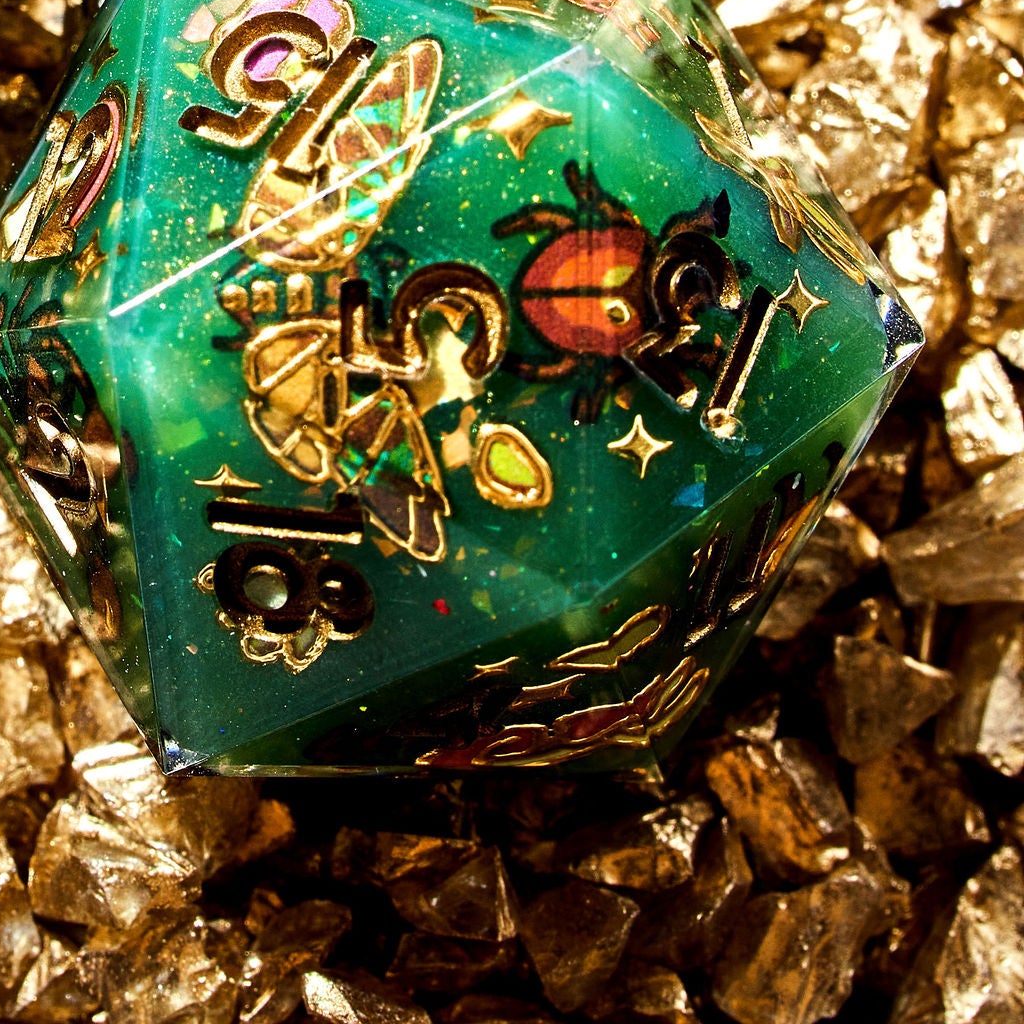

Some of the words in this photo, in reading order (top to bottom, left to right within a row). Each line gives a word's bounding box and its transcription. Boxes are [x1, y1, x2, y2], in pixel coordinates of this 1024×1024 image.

[178, 10, 378, 171] 15
[339, 262, 509, 378] 5
[207, 492, 375, 639] 18
